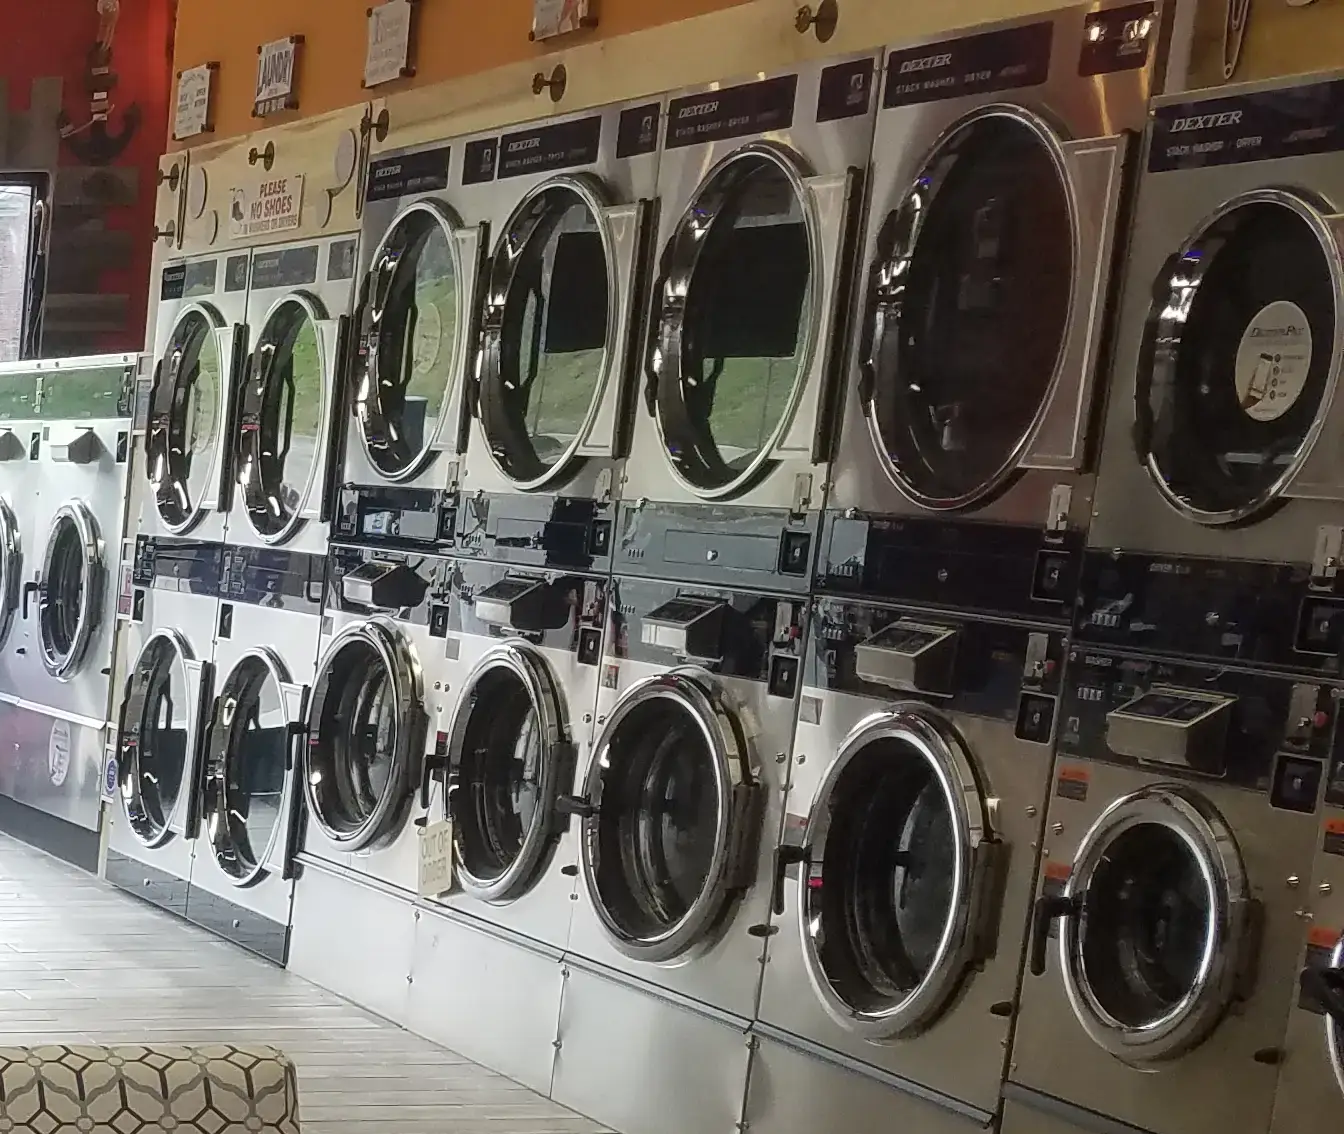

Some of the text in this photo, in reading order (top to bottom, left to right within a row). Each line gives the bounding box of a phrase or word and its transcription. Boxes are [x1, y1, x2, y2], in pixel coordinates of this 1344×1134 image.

[899, 52, 953, 75] DEXTER
[677, 100, 720, 119] DEXTER
[1169, 109, 1244, 134] DEXTER
[259, 178, 288, 199] PLEASE
[250, 194, 293, 219] NO SHOES
